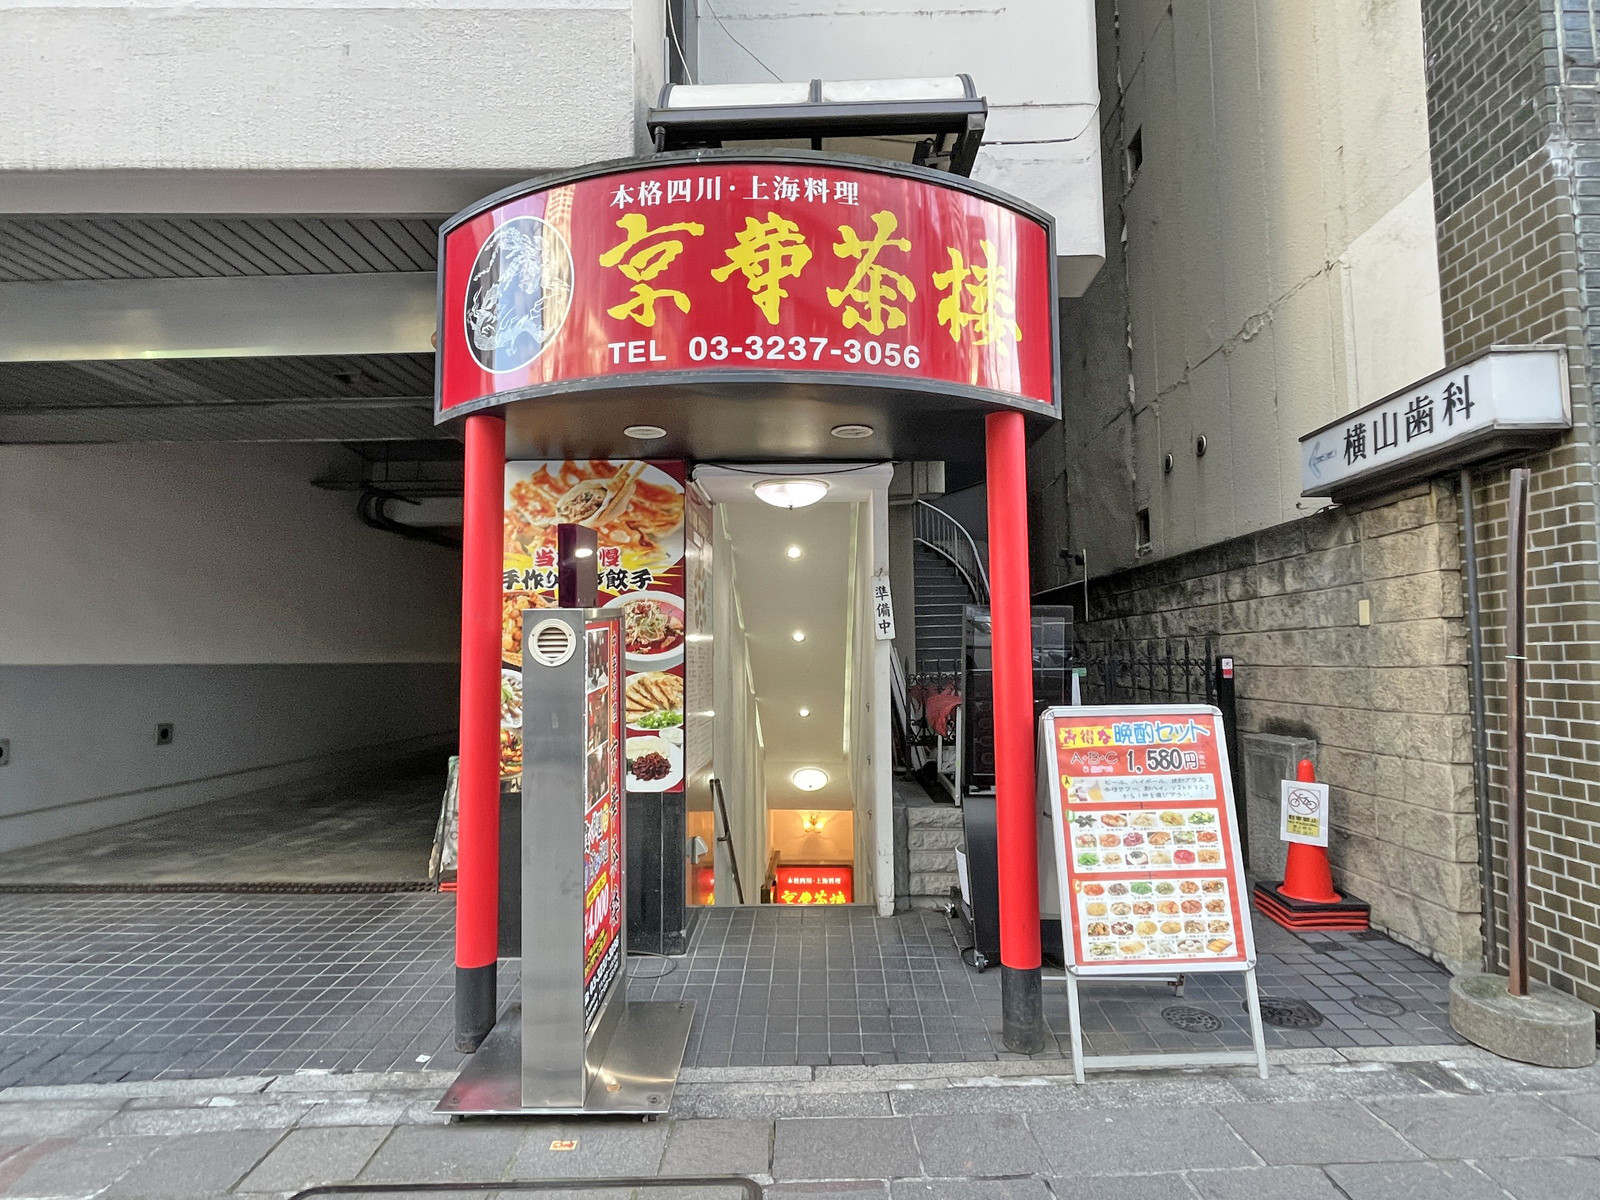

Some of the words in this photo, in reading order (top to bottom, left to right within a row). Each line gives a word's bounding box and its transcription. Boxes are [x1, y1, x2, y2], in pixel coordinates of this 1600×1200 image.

[609, 175, 860, 209] 本格四川・上海料理
[608, 340, 666, 364] TEL
[688, 335, 921, 369] 03-3237-3056
[1343, 374, 1475, 466] 横山歯科
[874, 585, 891, 635] 準備中
